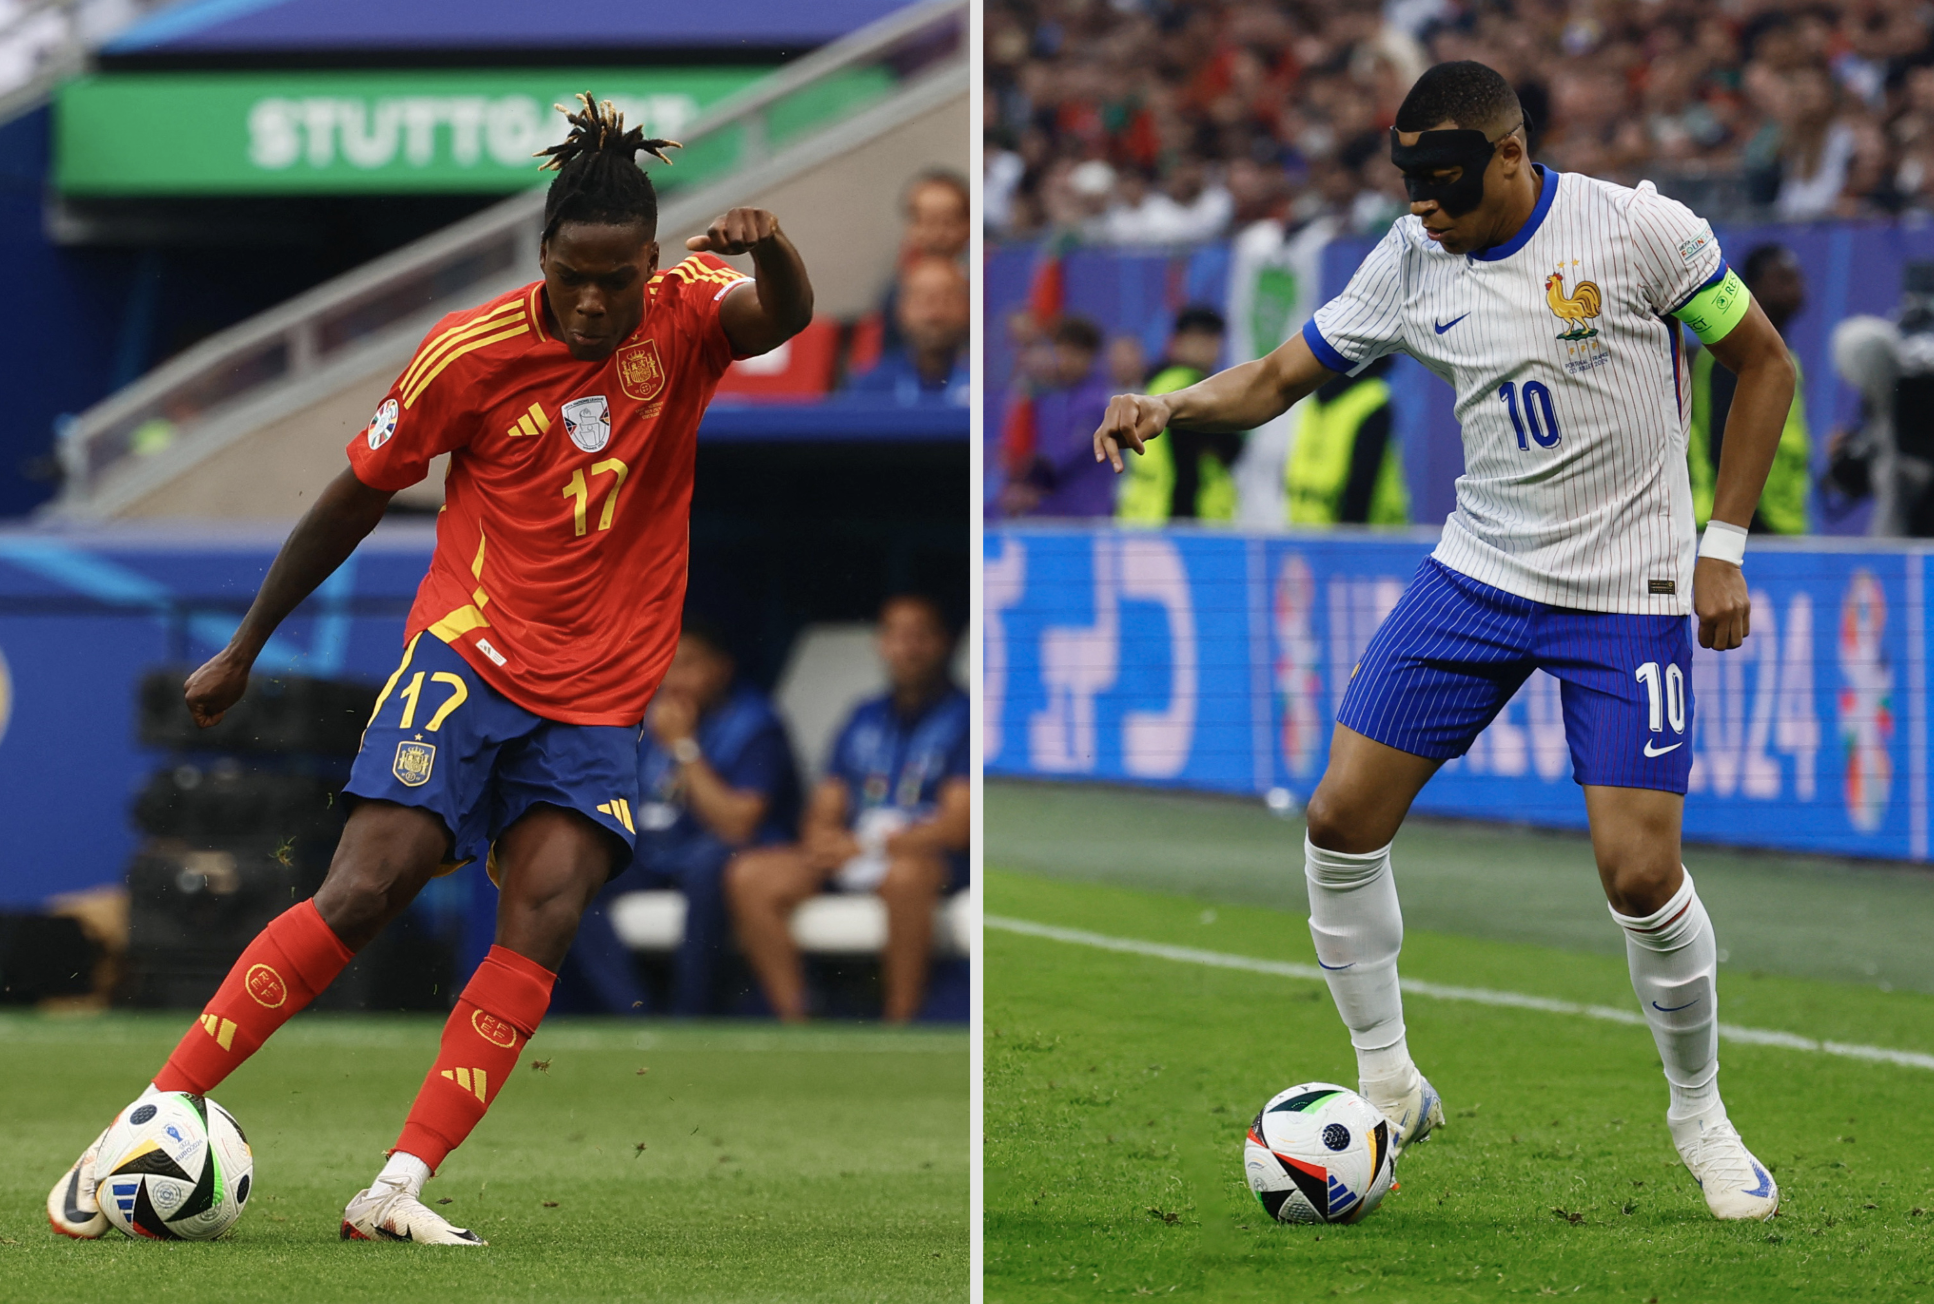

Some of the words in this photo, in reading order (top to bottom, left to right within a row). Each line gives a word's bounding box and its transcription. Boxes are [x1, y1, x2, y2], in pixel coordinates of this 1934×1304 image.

[1499, 380, 1562, 451] 10
[562, 457, 628, 537] 17
[399, 671, 468, 731] 17
[1635, 661, 1685, 735] 10
